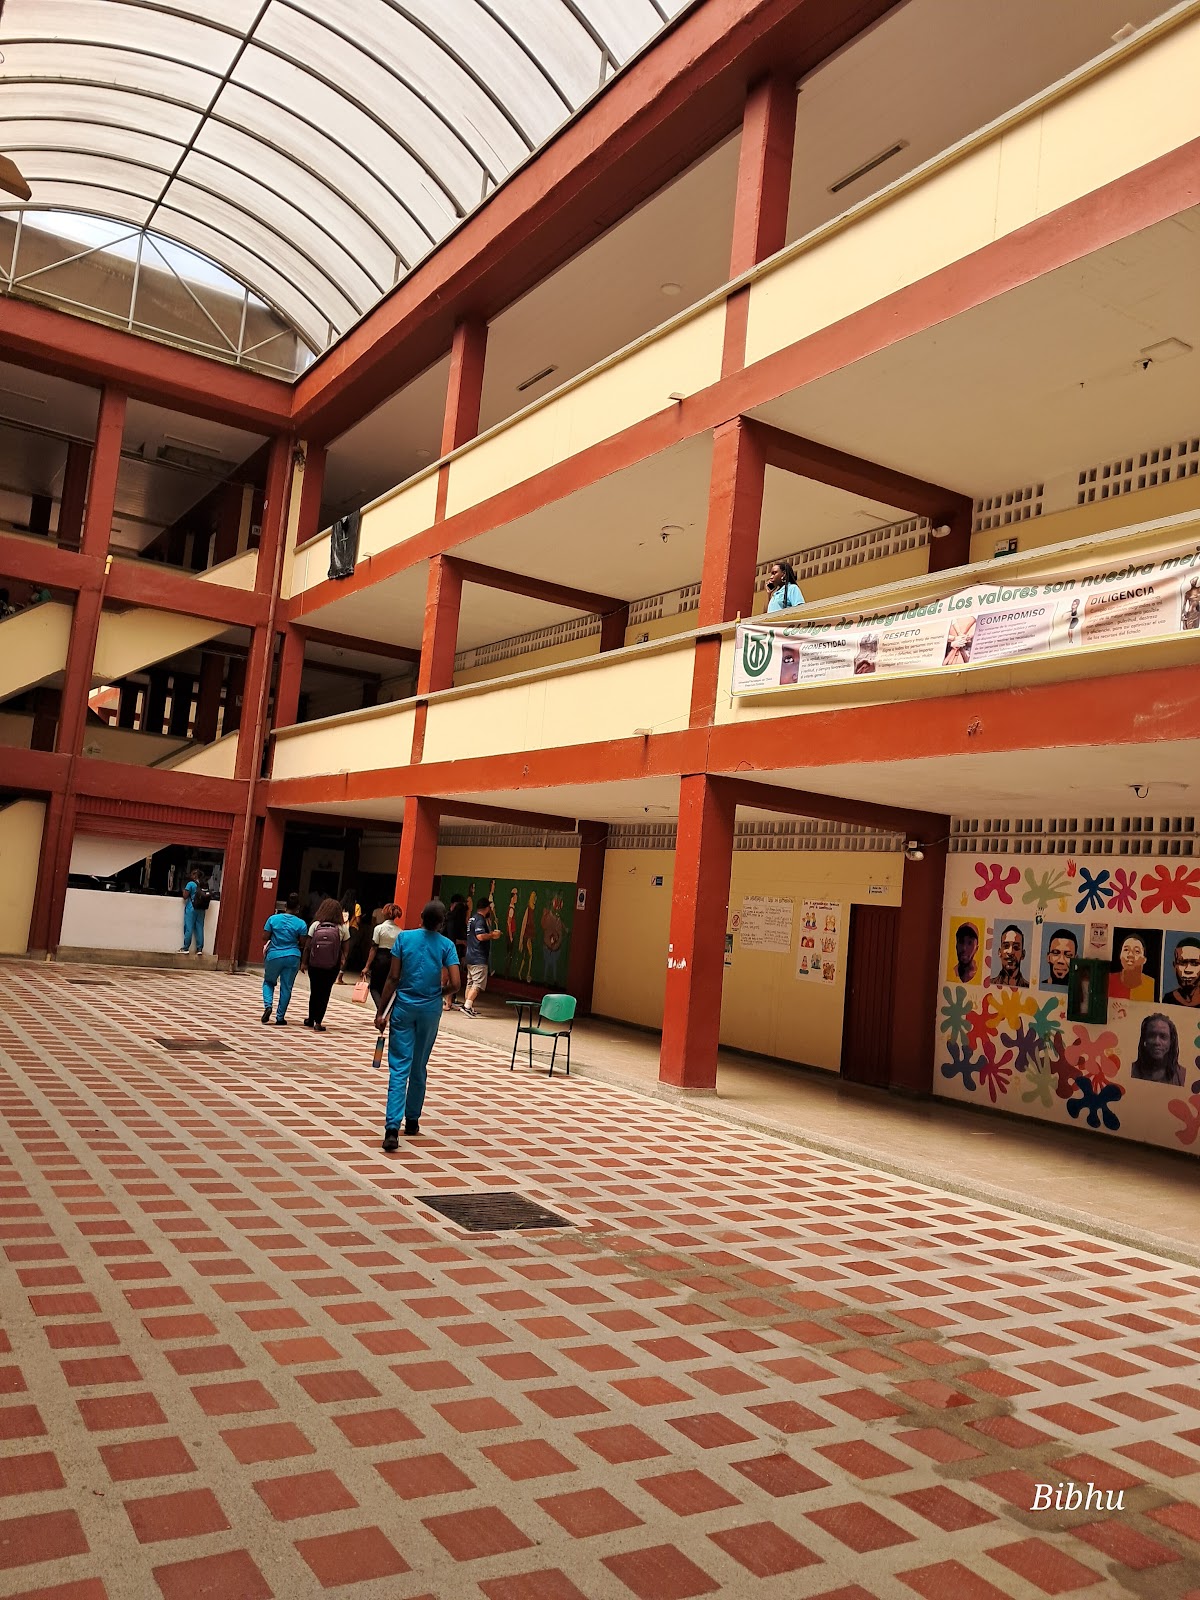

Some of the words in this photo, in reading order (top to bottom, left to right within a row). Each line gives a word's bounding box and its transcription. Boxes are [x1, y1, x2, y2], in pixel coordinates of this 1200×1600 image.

[783, 621, 832, 636] Código
[835, 617, 854, 631] de
[948, 596, 973, 612] Los
[978, 584, 1038, 606] valores
[1043, 577, 1079, 595] son
[1081, 562, 1156, 588] nuestra
[1160, 545, 1200, 571] mej
[1090, 586, 1155, 606] DILIGENCIA
[980, 608, 1046, 625] COMPROMISO
[884, 629, 921, 640] RESPETO
[801, 639, 847, 650] HONESTIDAD
